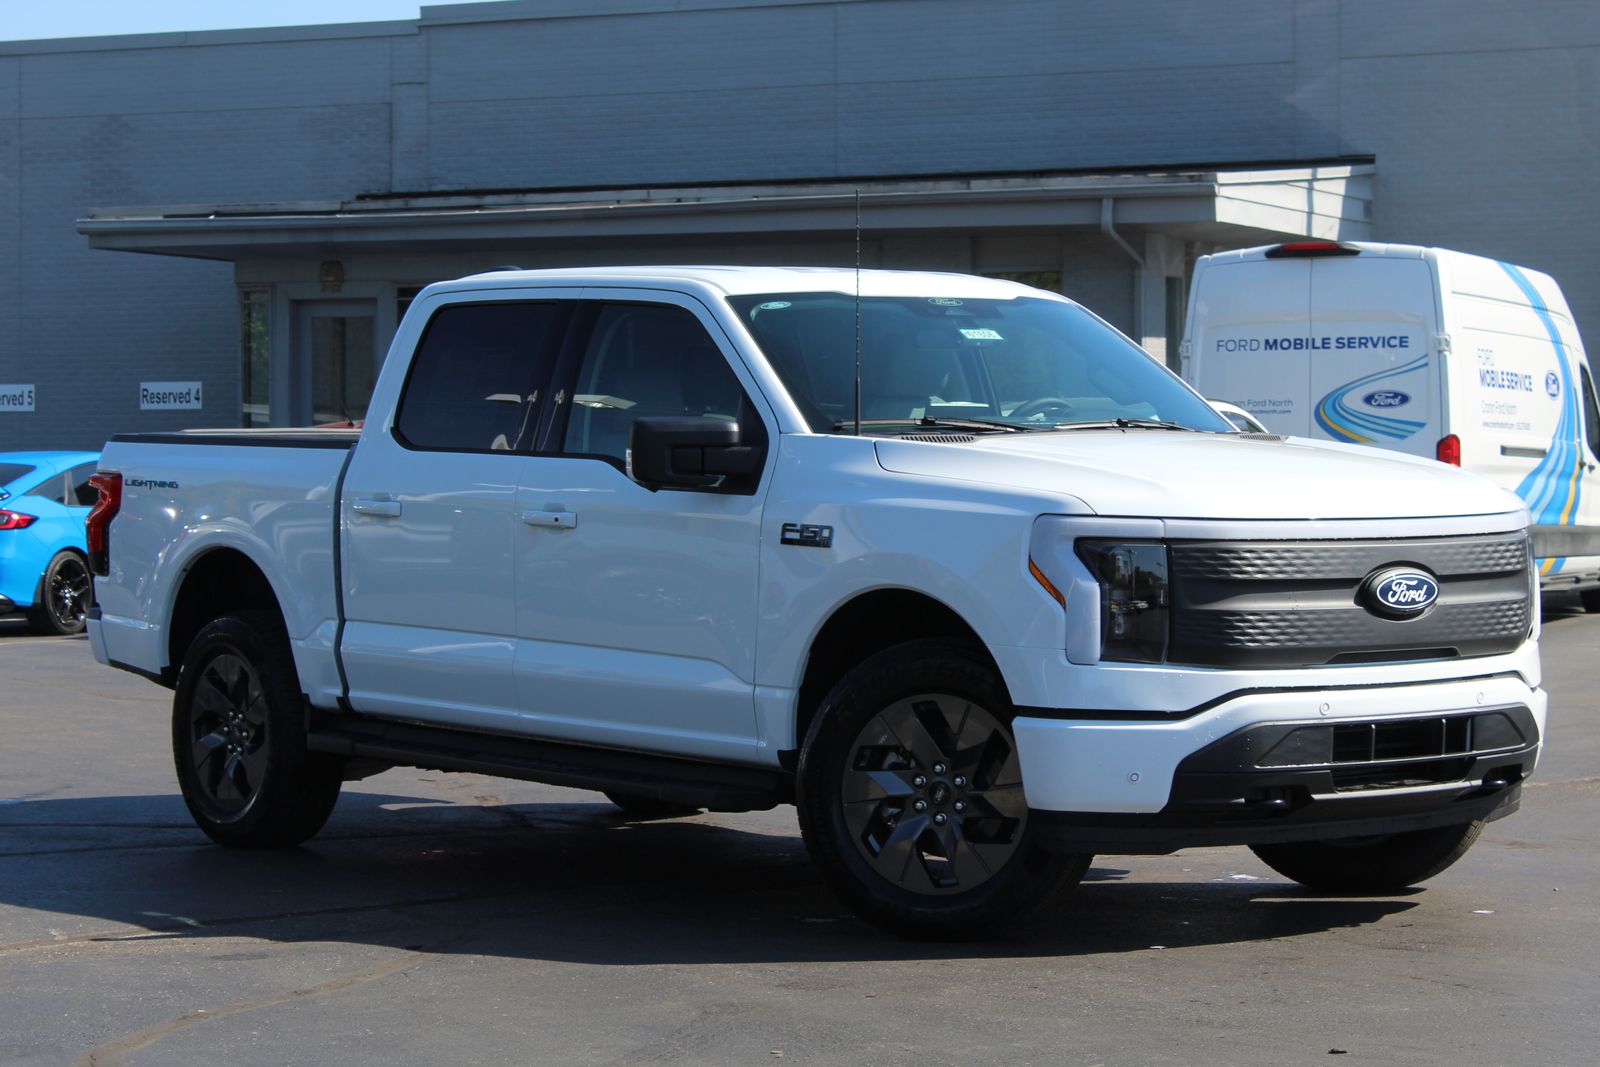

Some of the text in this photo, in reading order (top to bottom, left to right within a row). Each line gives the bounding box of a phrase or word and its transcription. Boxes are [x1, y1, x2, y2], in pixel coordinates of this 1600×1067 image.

[1216, 336, 1409, 352] FORD MOBILE SERVICE
[0, 390, 33, 406] rved 5
[142, 388, 200, 404] Reserved 4
[1247, 399, 1267, 407] Ford
[1268, 399, 1294, 407] North
[1371, 392, 1402, 406] Ford
[125, 479, 179, 490] LIGHTNING
[1388, 580, 1427, 603] Ford
